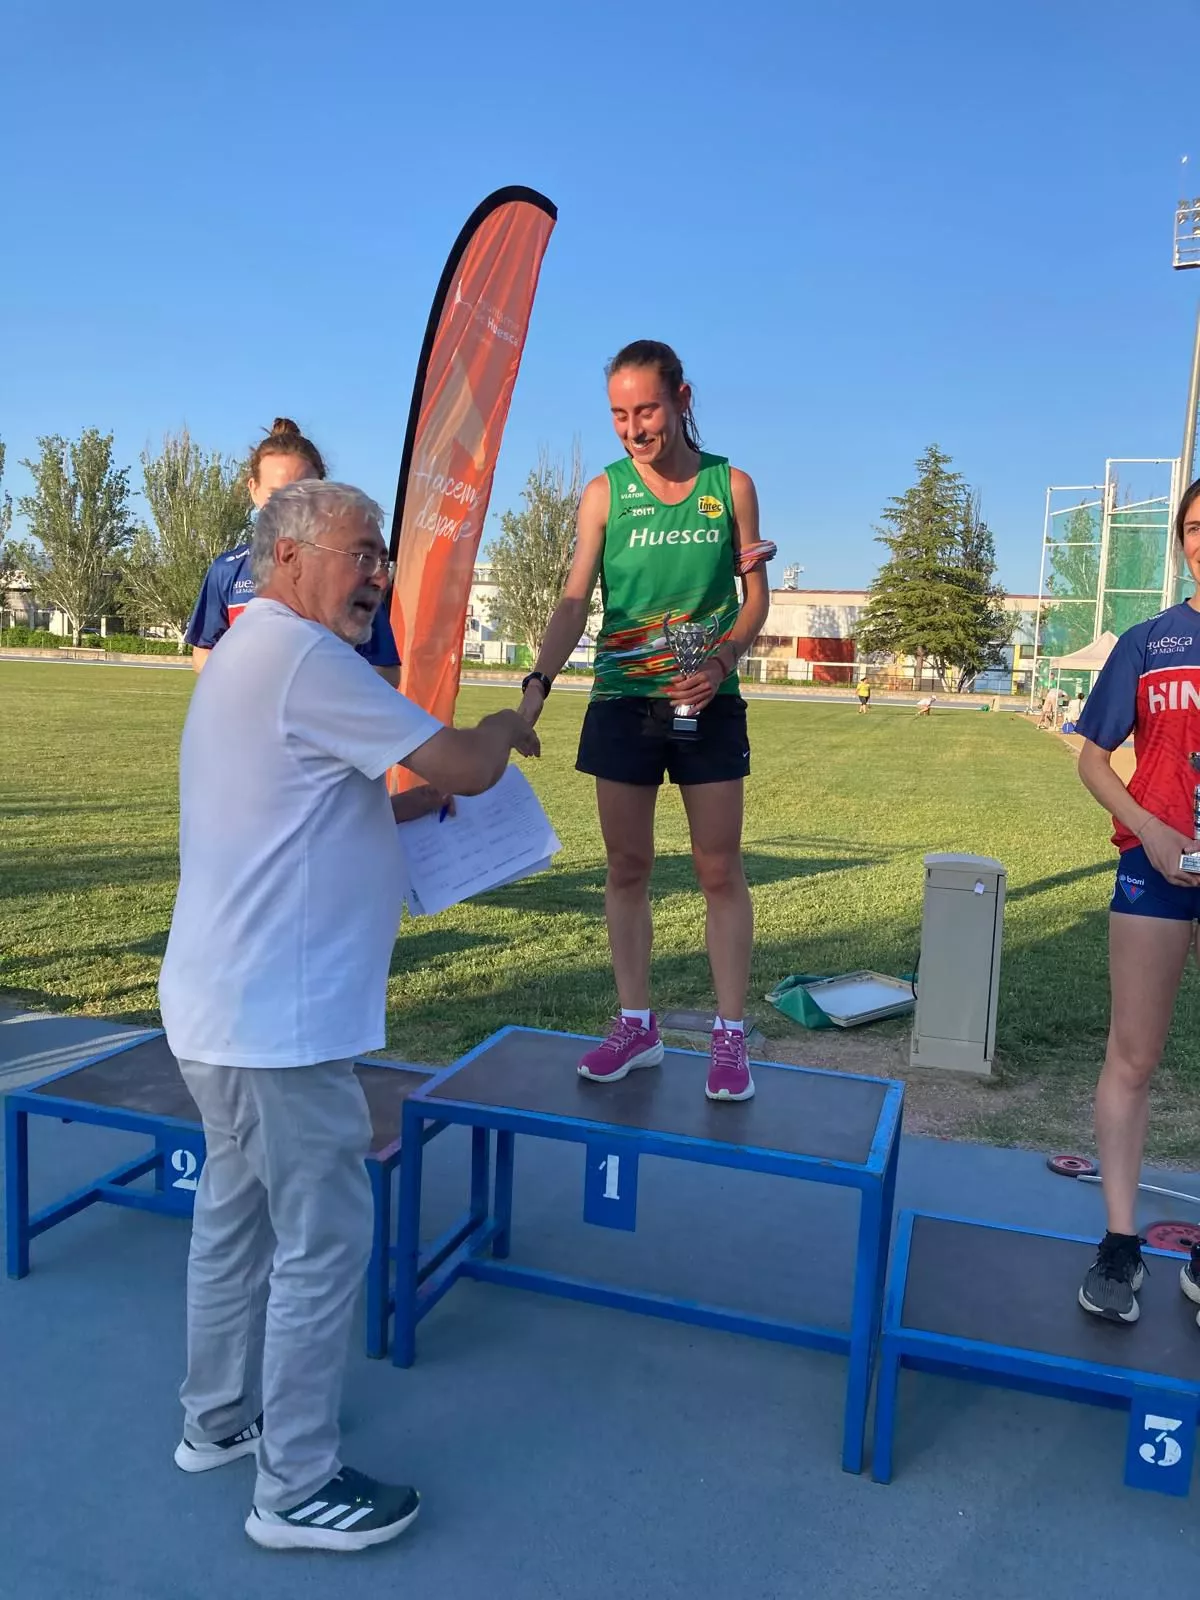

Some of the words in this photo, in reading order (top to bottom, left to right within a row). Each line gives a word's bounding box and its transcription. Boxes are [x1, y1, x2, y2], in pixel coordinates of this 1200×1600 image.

[629, 528, 719, 548] Huesca
[171, 1149, 199, 1191] 2
[598, 1154, 620, 1200] 1
[1139, 1414, 1183, 1467] 3
